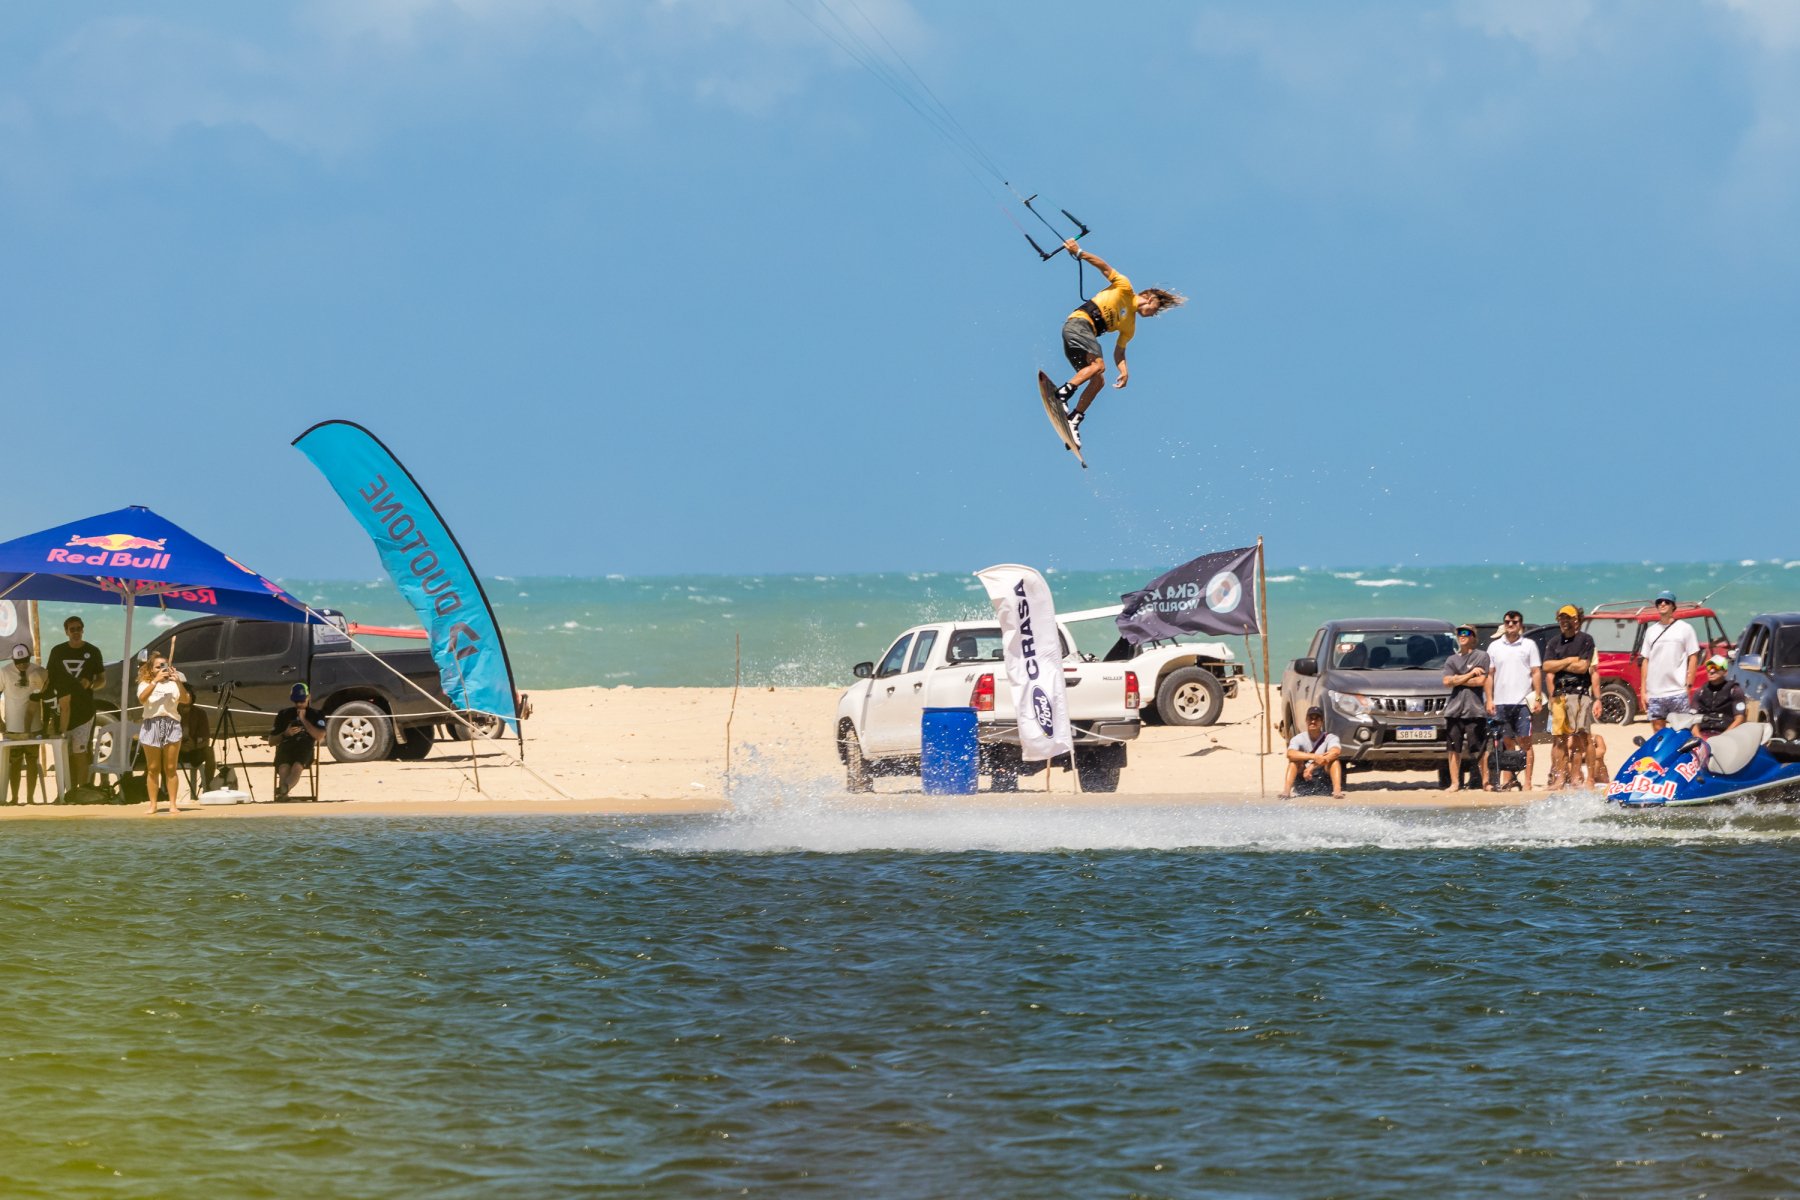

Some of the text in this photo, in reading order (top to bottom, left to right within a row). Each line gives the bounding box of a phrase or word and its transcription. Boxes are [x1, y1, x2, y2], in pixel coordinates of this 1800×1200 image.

[46, 548, 171, 570] Red Bull
[1013, 578, 1040, 681] CRASA
[1034, 695, 1053, 728] Ford
[1608, 776, 1677, 800] Red Bull
